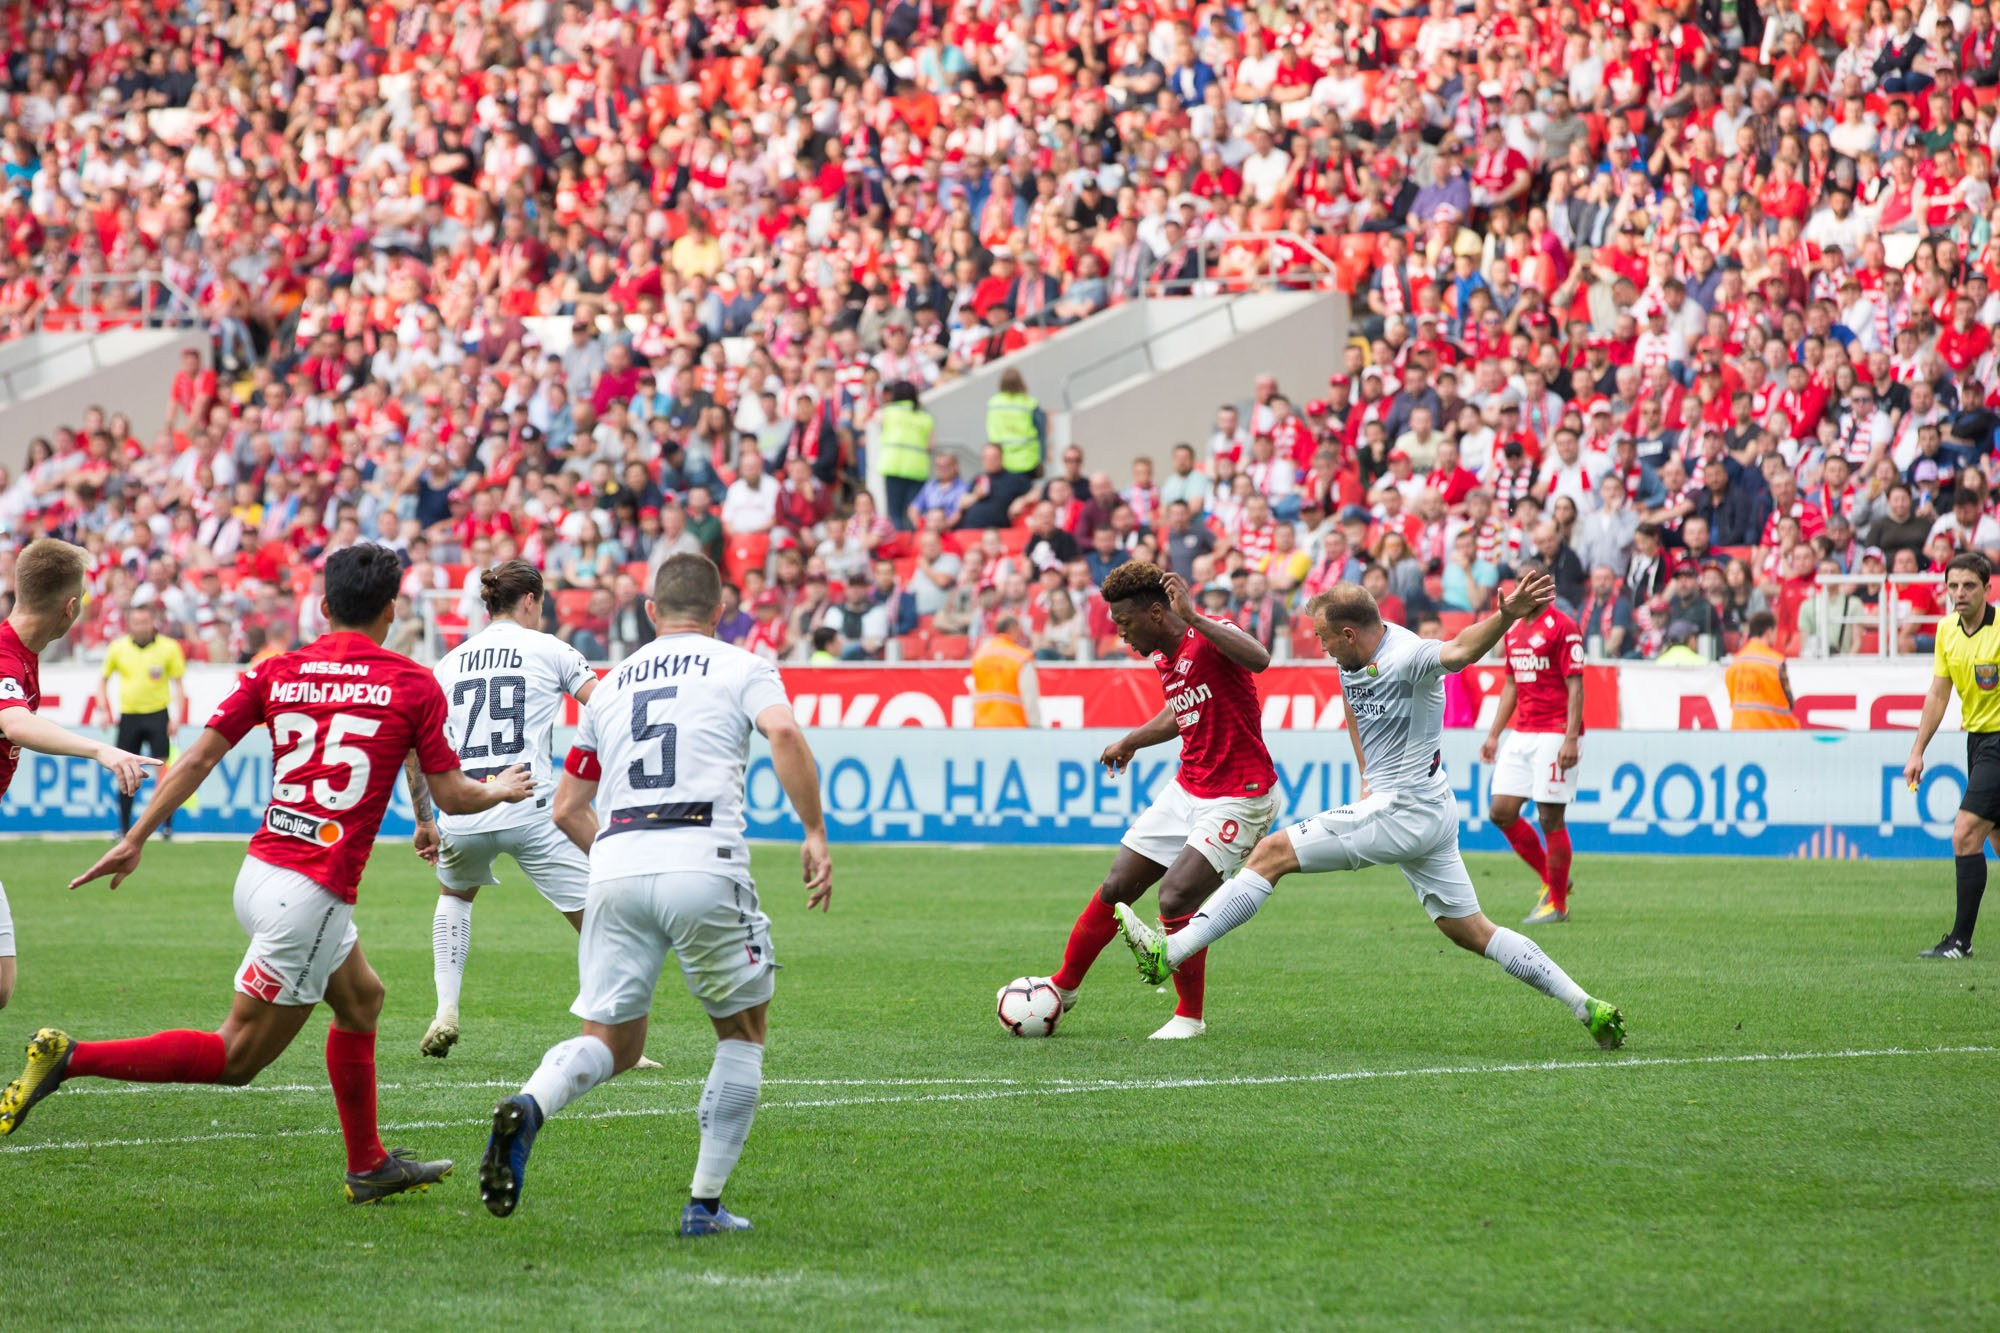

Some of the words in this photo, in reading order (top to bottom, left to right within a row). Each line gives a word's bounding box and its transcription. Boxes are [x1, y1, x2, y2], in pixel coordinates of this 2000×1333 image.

[299, 661, 370, 676] NISSAN
[459, 648, 523, 673] ТИЛЛЬ
[618, 654, 710, 690] ЙОКИЧ
[270, 681, 392, 706] МЕЛЬГАРЕХО
[1166, 683, 1213, 713] УКОЙЛ
[452, 675, 526, 761] 29
[628, 685, 678, 790] 5
[272, 712, 382, 811] 25
[942, 757, 1039, 827] НА
[1054, 759, 1184, 829] РЕК
[1878, 762, 1969, 841] ГО
[1218, 819, 1239, 844] 9
